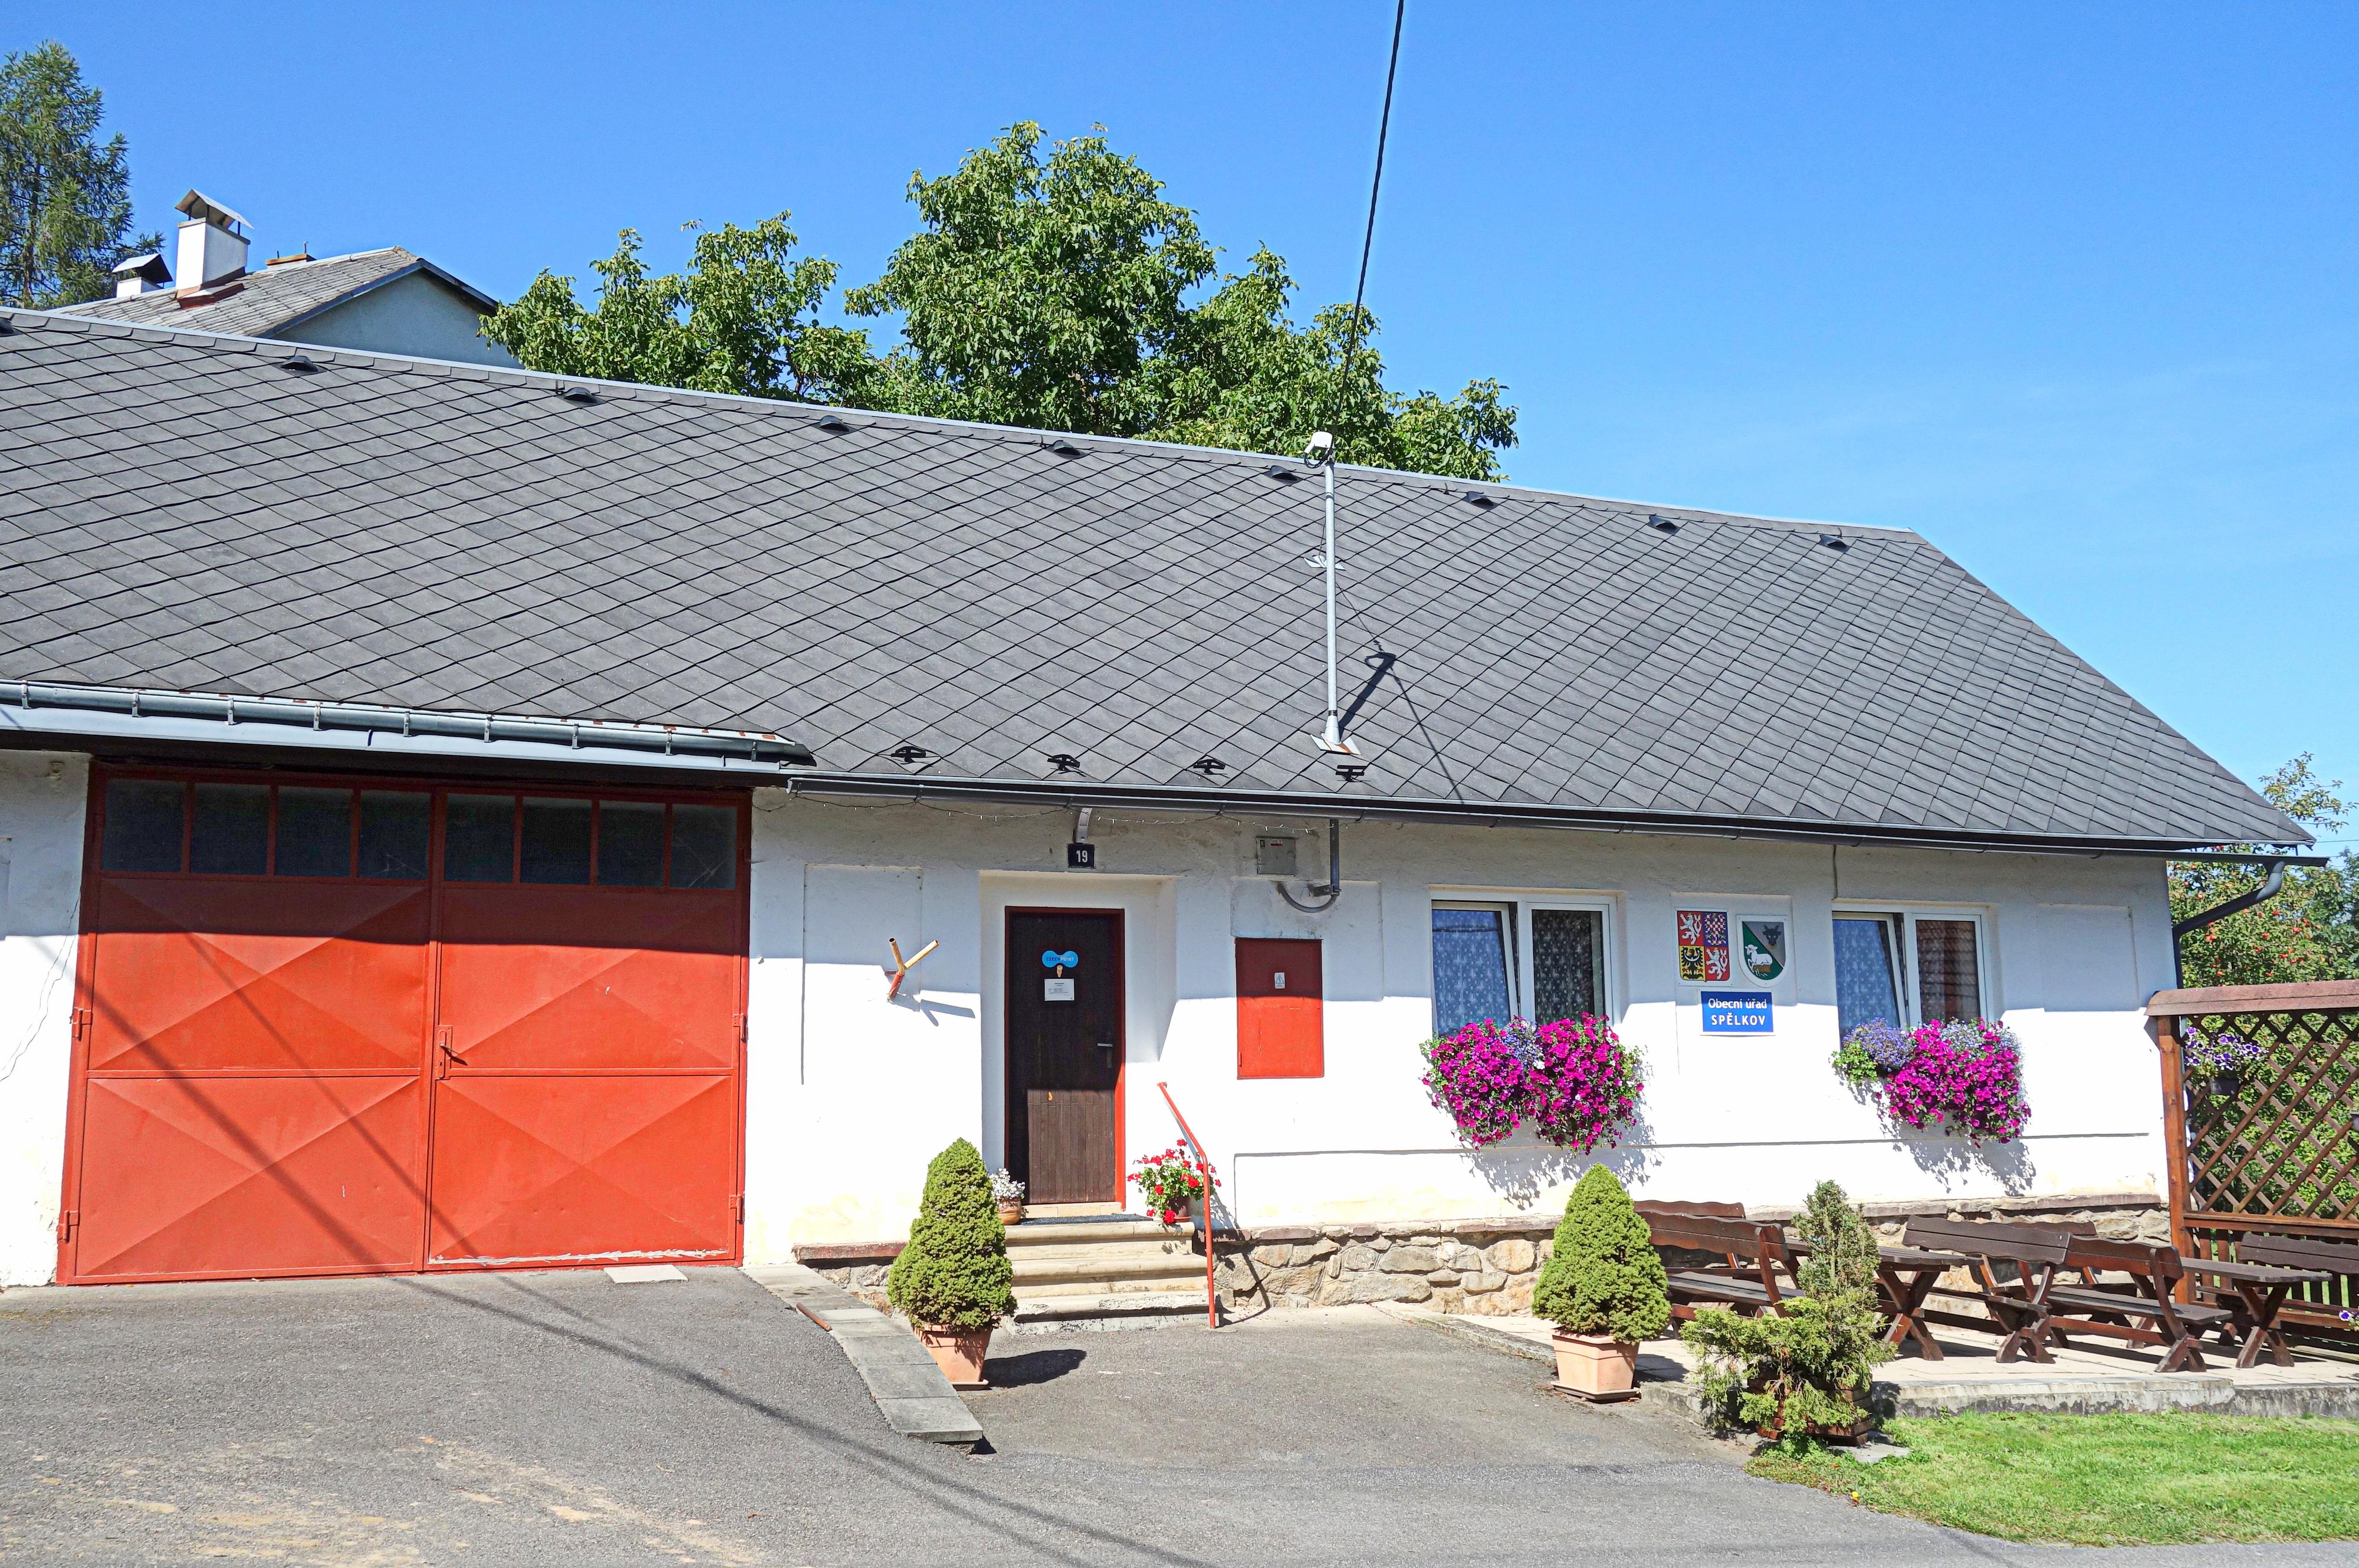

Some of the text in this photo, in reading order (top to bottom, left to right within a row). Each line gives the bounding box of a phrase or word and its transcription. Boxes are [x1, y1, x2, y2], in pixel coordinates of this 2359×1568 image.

[1076, 850, 1088, 863] 19
[1708, 998, 1767, 1009] Obecní úřad
[1711, 1012, 1766, 1025] SPĚLKOV
